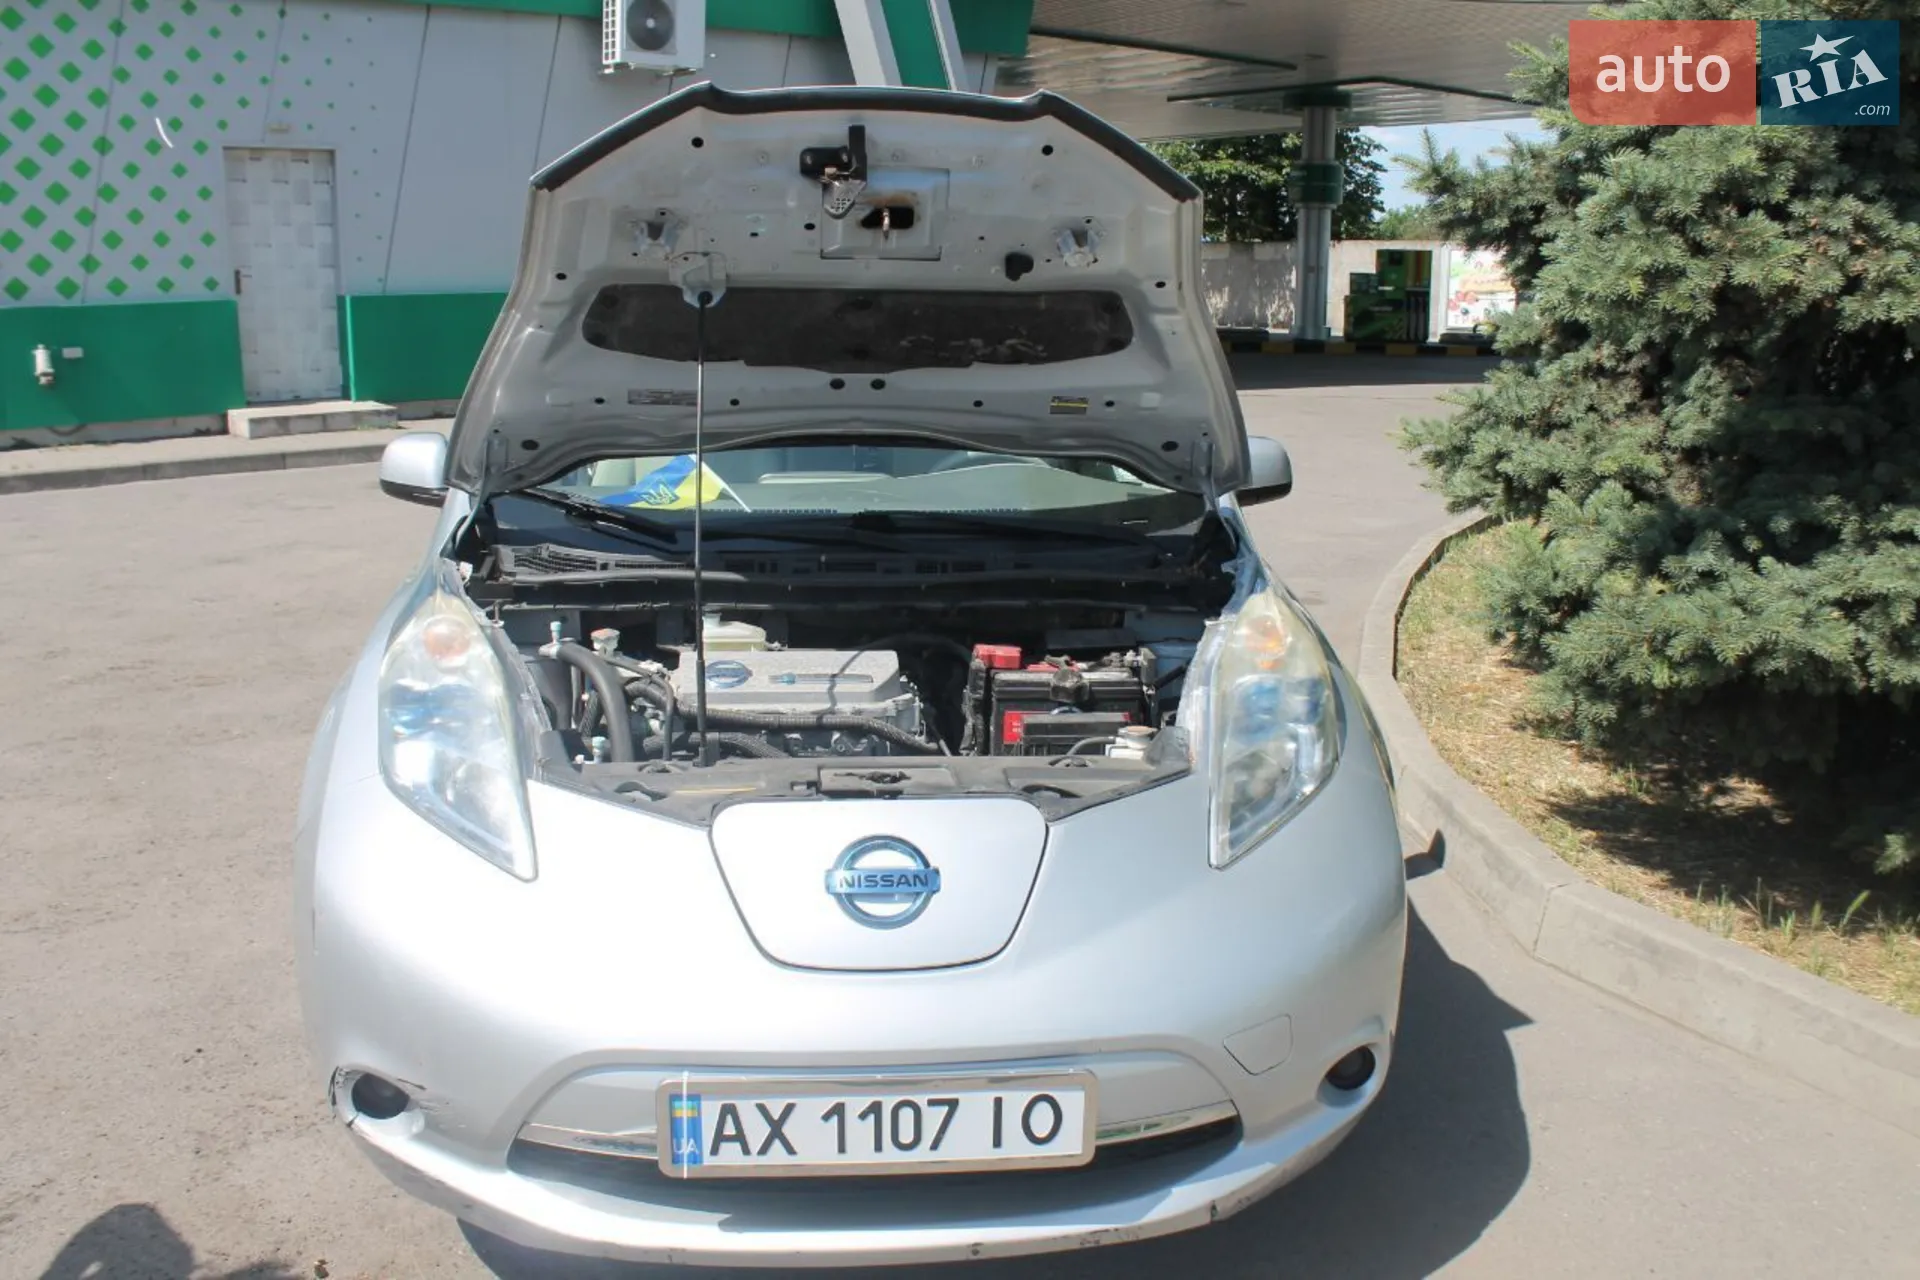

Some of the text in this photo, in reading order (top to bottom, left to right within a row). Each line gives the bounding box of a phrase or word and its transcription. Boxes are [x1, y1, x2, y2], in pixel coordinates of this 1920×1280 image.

[839, 873, 929, 888] NISSAN
[709, 1094, 1063, 1156] AX 1107 IO
[673, 1137, 699, 1155] UA
